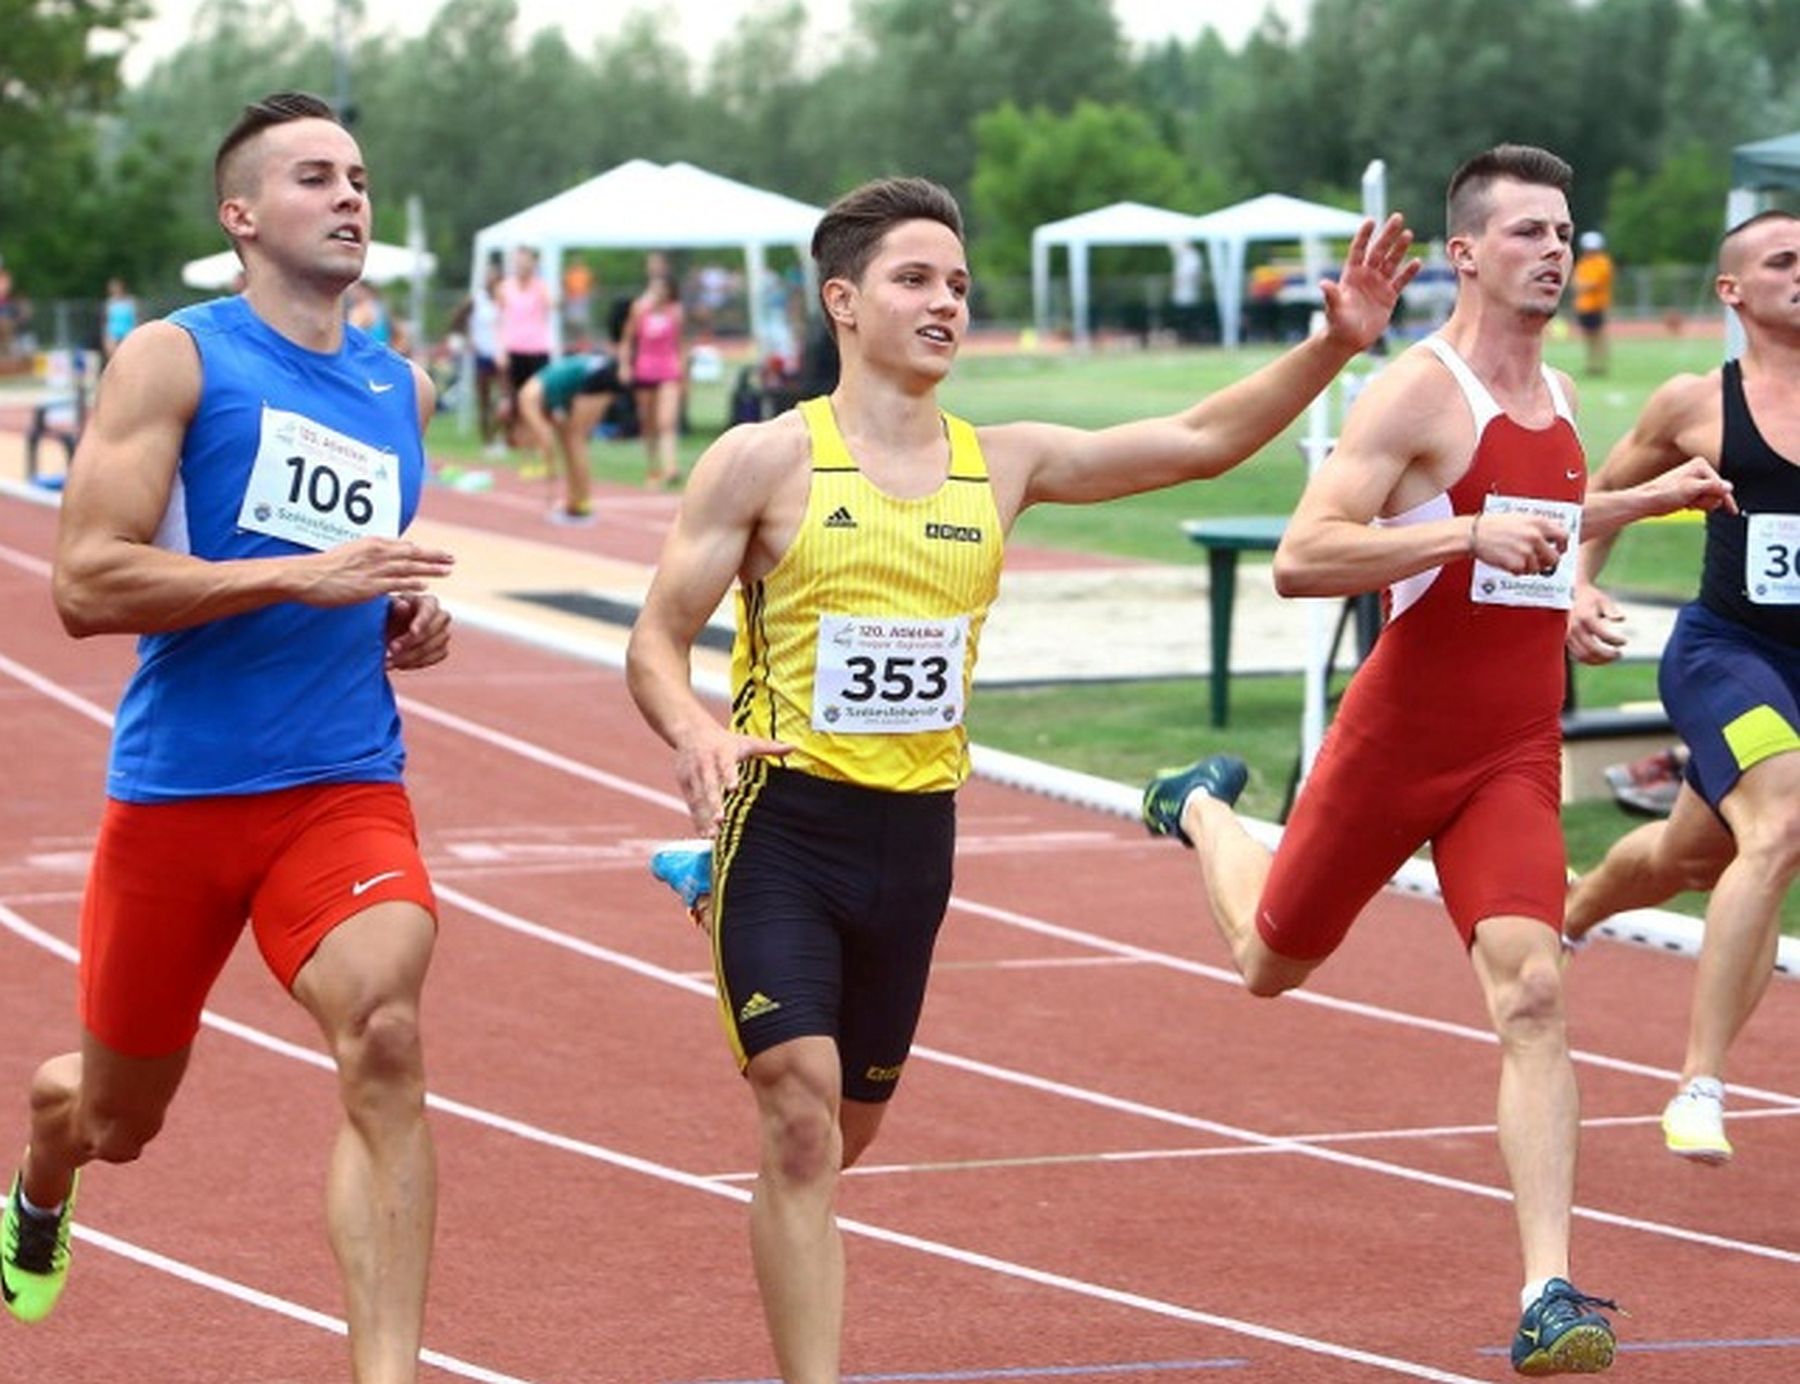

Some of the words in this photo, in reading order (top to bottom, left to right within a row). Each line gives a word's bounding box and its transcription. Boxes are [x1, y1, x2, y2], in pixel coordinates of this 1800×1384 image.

[286, 456, 374, 525] 106
[1764, 544, 1800, 578] 3
[841, 656, 948, 702] 353
